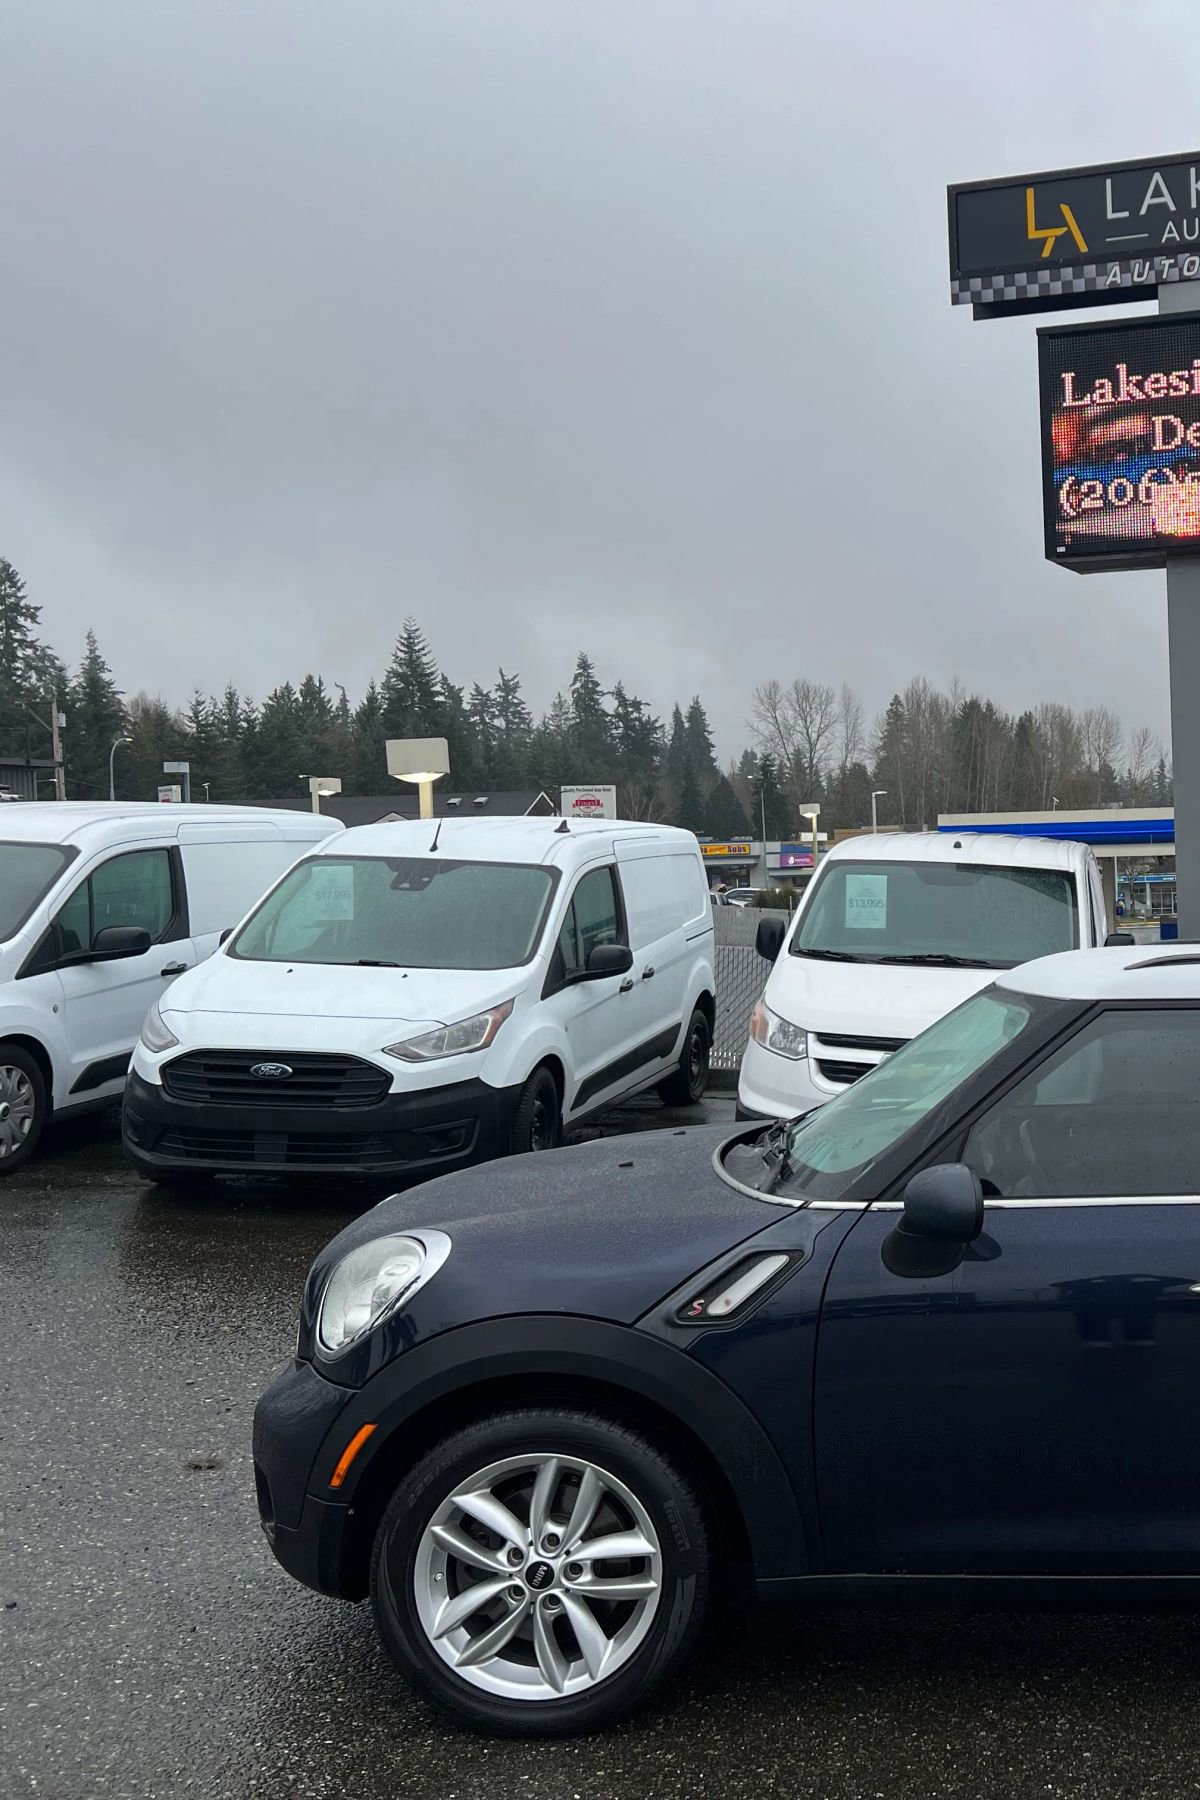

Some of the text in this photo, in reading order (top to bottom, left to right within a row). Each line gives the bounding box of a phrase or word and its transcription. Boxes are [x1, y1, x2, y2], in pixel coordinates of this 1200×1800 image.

[1105, 255, 1200, 286] AUTO
[258, 1065, 282, 1076] Ford
[687, 1299, 705, 1316] S
[531, 1564, 549, 1587] MINI
